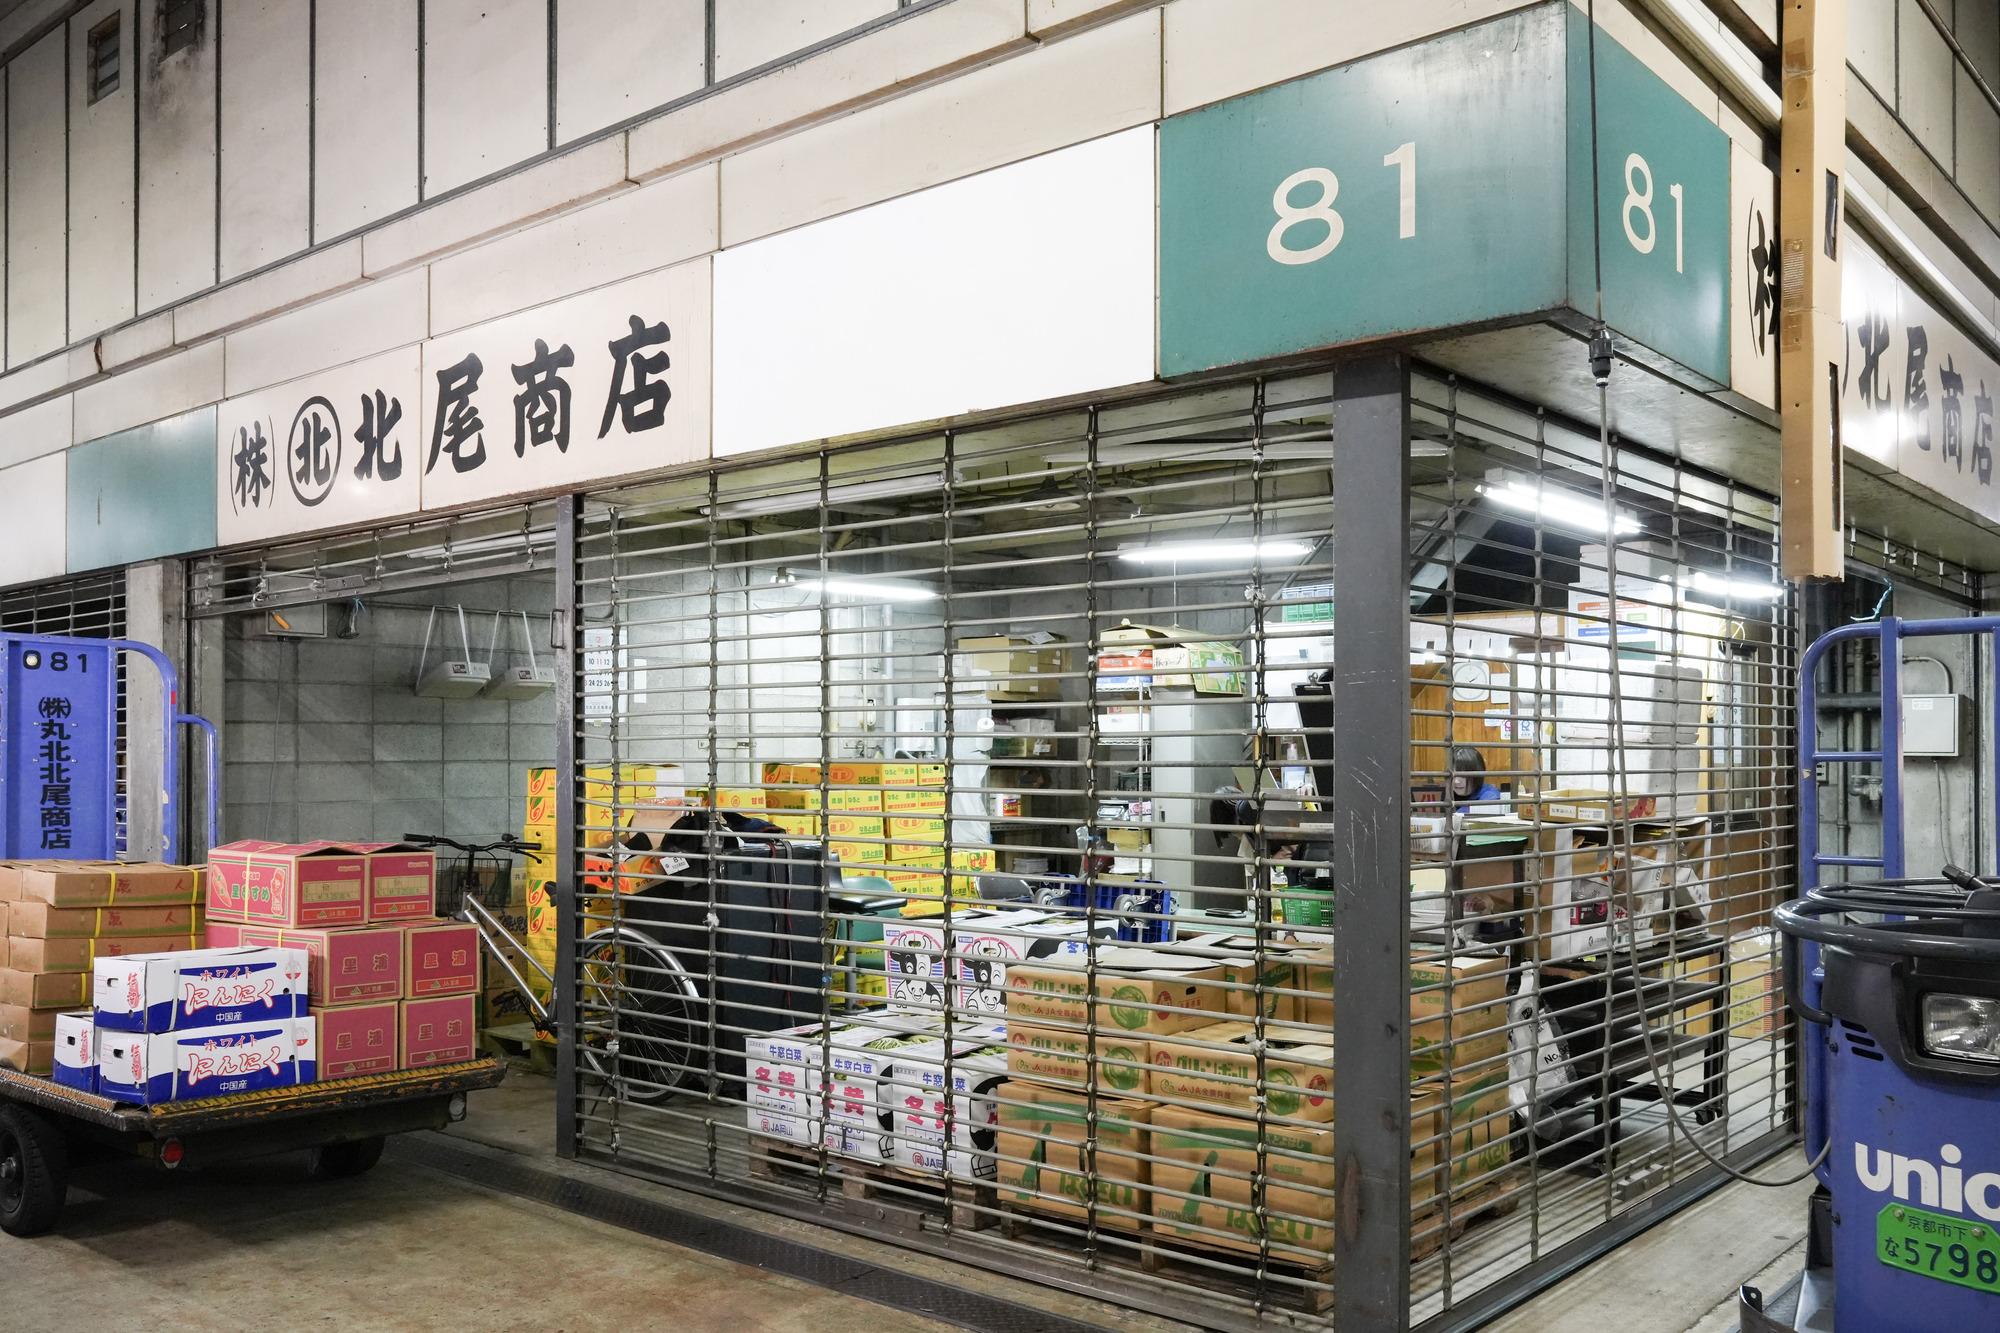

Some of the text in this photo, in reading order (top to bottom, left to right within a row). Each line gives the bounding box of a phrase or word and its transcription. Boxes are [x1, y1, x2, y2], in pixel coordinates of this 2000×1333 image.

[22, 650, 88, 674] 081
[200, 966, 252, 982] ホワイト
[184, 979, 275, 1016] にんにく
[215, 1011, 243, 1023] 中国産
[204, 1034, 258, 1052] ホワイト
[187, 1046, 281, 1086] にんにく
[219, 1079, 248, 1092] 中国産
[1908, 1216, 1968, 1241] 京都市下
[1884, 1236, 1998, 1284] な 5798
